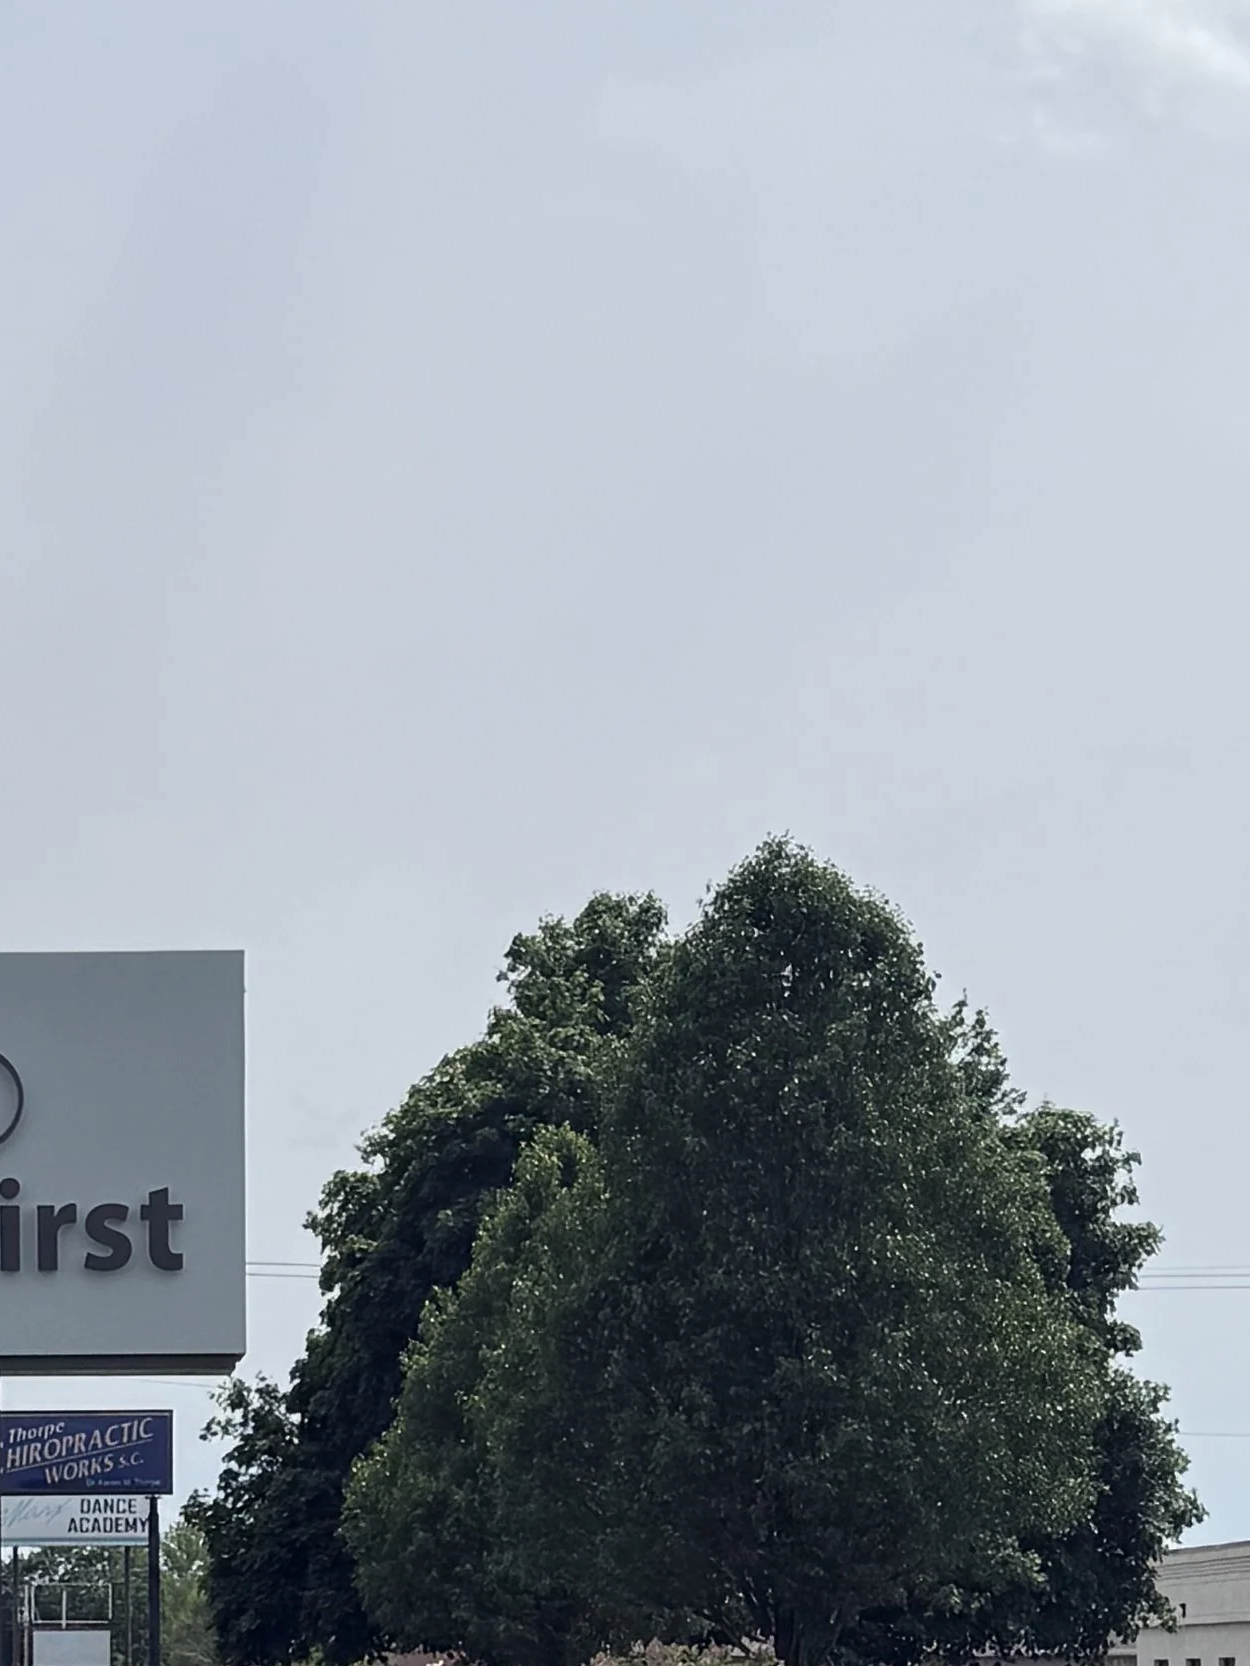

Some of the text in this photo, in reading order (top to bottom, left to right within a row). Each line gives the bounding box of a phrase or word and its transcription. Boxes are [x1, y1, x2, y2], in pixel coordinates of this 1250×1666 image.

[9, 1421, 65, 1443] Thorpe
[0, 1417, 154, 1474] HIROPRACTIC
[45, 1453, 114, 1484] WORKS
[80, 1498, 137, 1514] DANCE
[68, 1517, 149, 1533] ACADEMY
